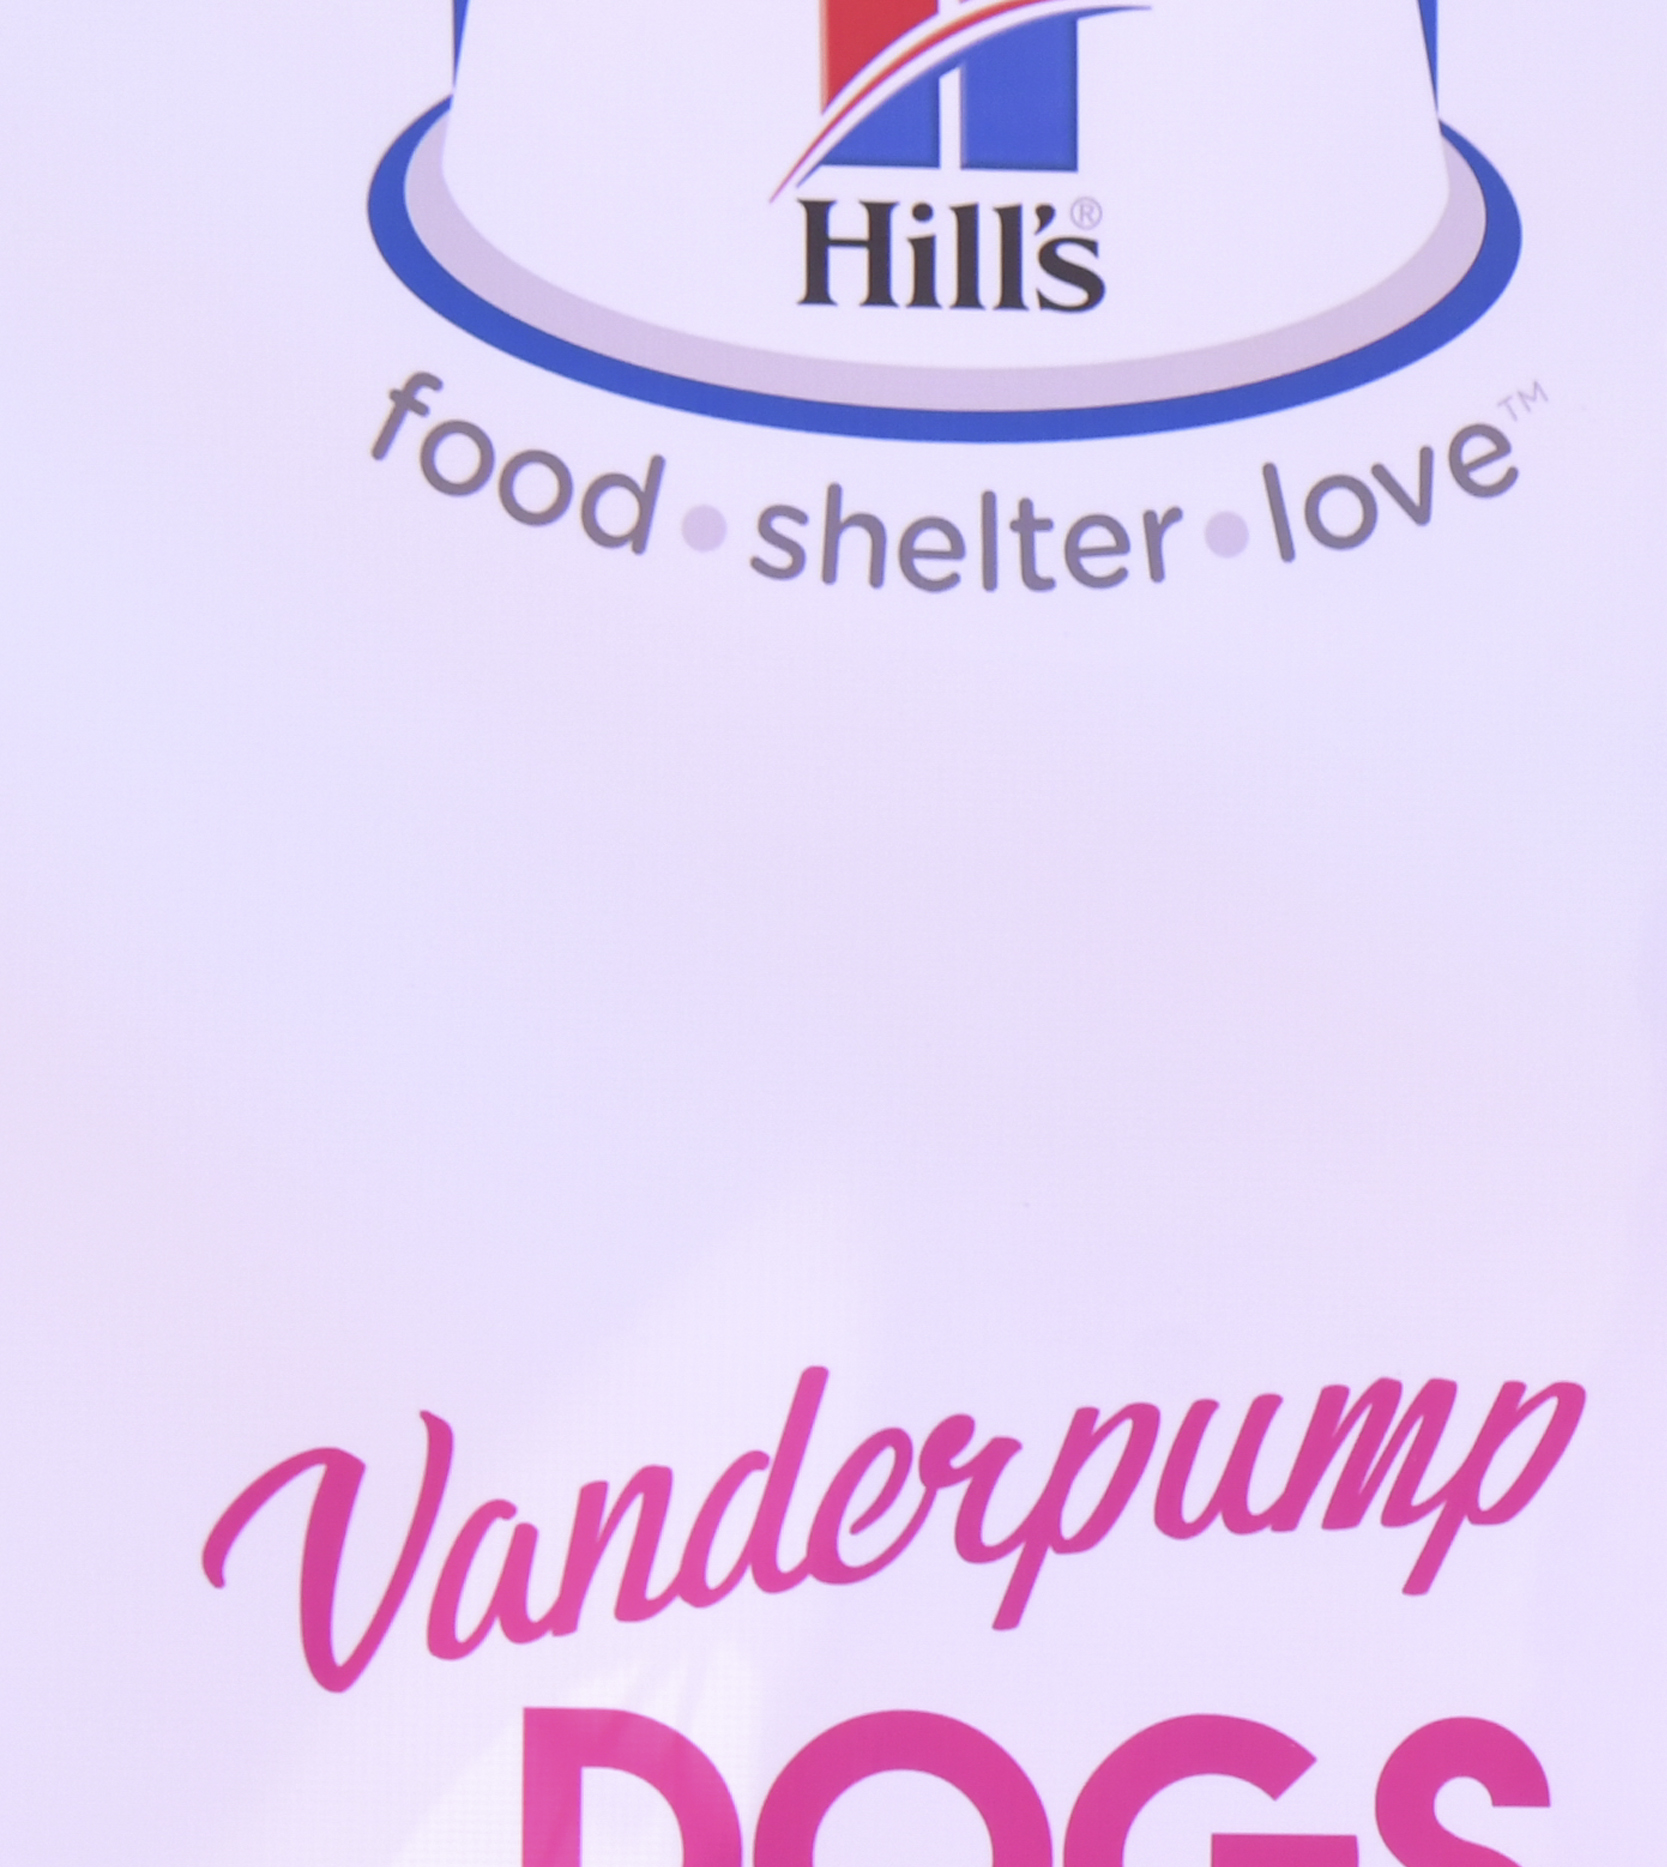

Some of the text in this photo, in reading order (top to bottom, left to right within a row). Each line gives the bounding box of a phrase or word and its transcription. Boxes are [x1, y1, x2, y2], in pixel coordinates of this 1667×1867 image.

[370, 371, 666, 555] food
[750, 482, 1184, 594] shelter
[200, 1364, 1588, 1695] Vanderpump
